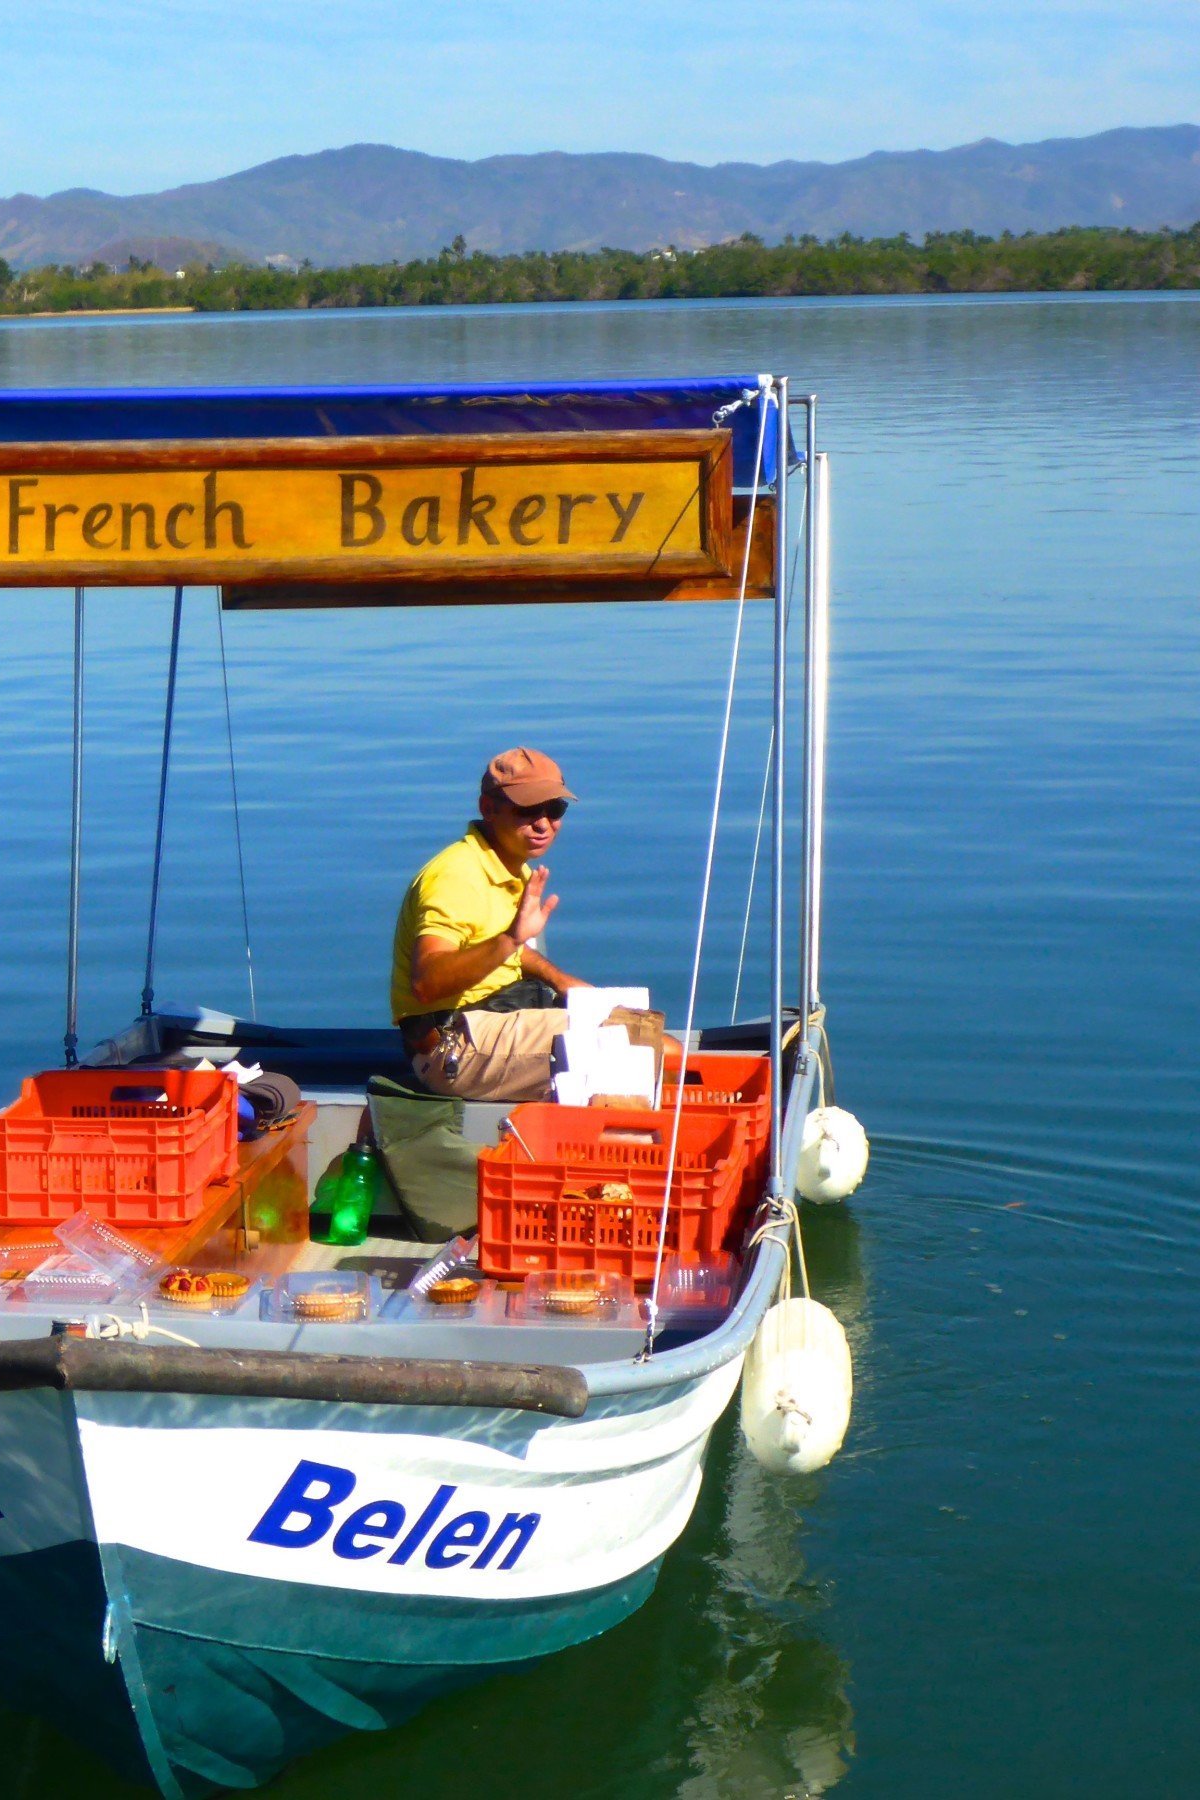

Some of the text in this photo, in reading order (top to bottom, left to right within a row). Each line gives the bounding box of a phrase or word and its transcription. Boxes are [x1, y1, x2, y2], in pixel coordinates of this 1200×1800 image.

[7, 467, 646, 554] French Bakery
[246, 1459, 542, 1571] Belen
